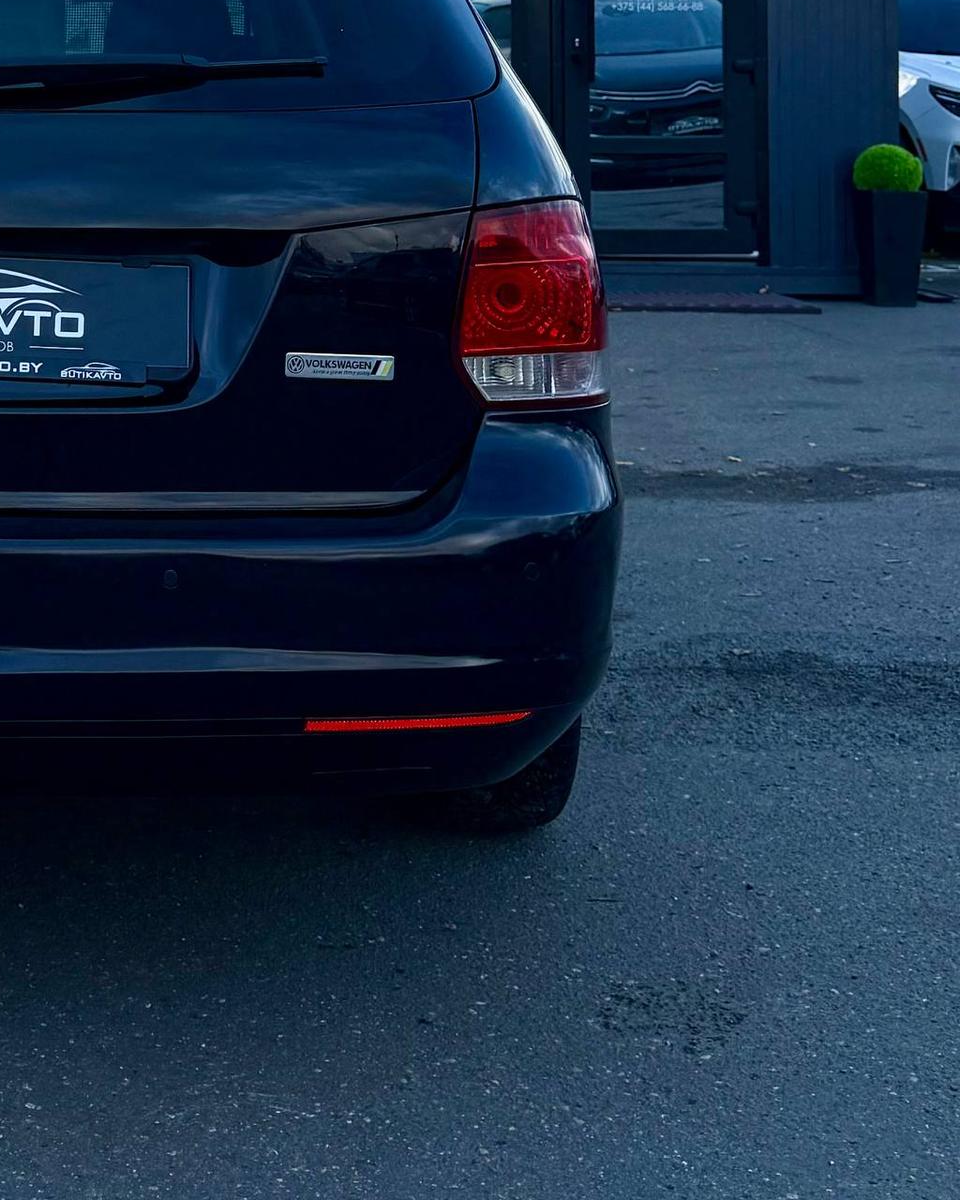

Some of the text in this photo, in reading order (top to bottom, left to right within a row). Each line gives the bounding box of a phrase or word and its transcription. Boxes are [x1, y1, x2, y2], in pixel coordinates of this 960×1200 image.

[612, 2, 634, 11] +375
[305, 359, 372, 371] VOLKSWAGEN
[60, 368, 122, 380] BUTIKAVTO
